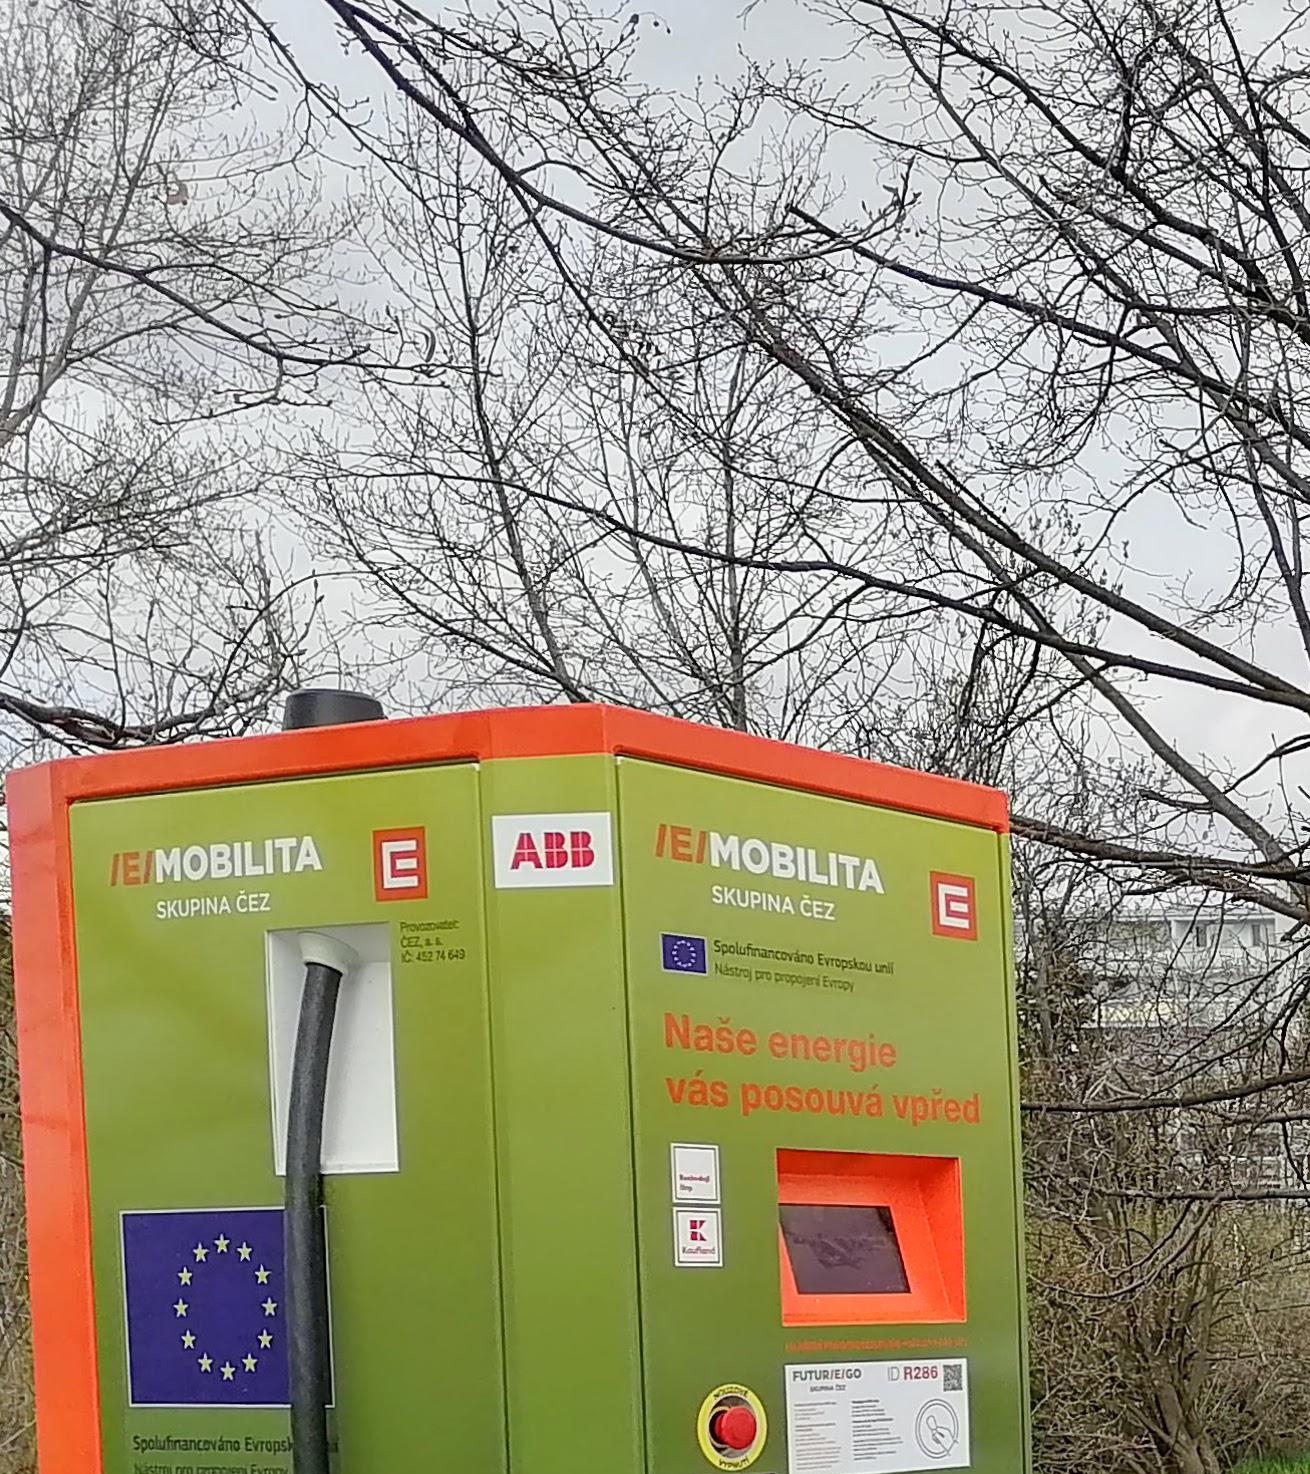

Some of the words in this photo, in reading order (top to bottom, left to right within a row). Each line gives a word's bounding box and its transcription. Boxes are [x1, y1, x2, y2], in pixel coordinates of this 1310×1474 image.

[510, 831, 596, 870] ABB
[156, 896, 231, 919] SKUPINA
[236, 889, 271, 913] ČEZ
[711, 886, 795, 915] SKUPINA
[800, 893, 836, 921] ČEZ
[713, 940, 814, 966] Spolufinancováno
[817, 953, 873, 972] Evropskou
[714, 963, 752, 981] Nástroj
[755, 969, 772, 982] pro
[822, 975, 854, 992] Evropy
[664, 1012, 757, 1058] Naše
[768, 1032, 897, 1073] energie
[666, 1070, 730, 1109] vás
[741, 1078, 883, 1117] posouvá
[892, 1094, 981, 1126] vpřed
[887, 1367, 899, 1381] ID
[904, 1366, 938, 1380] R286
[133, 1435, 241, 1452] Spolufinancováno
